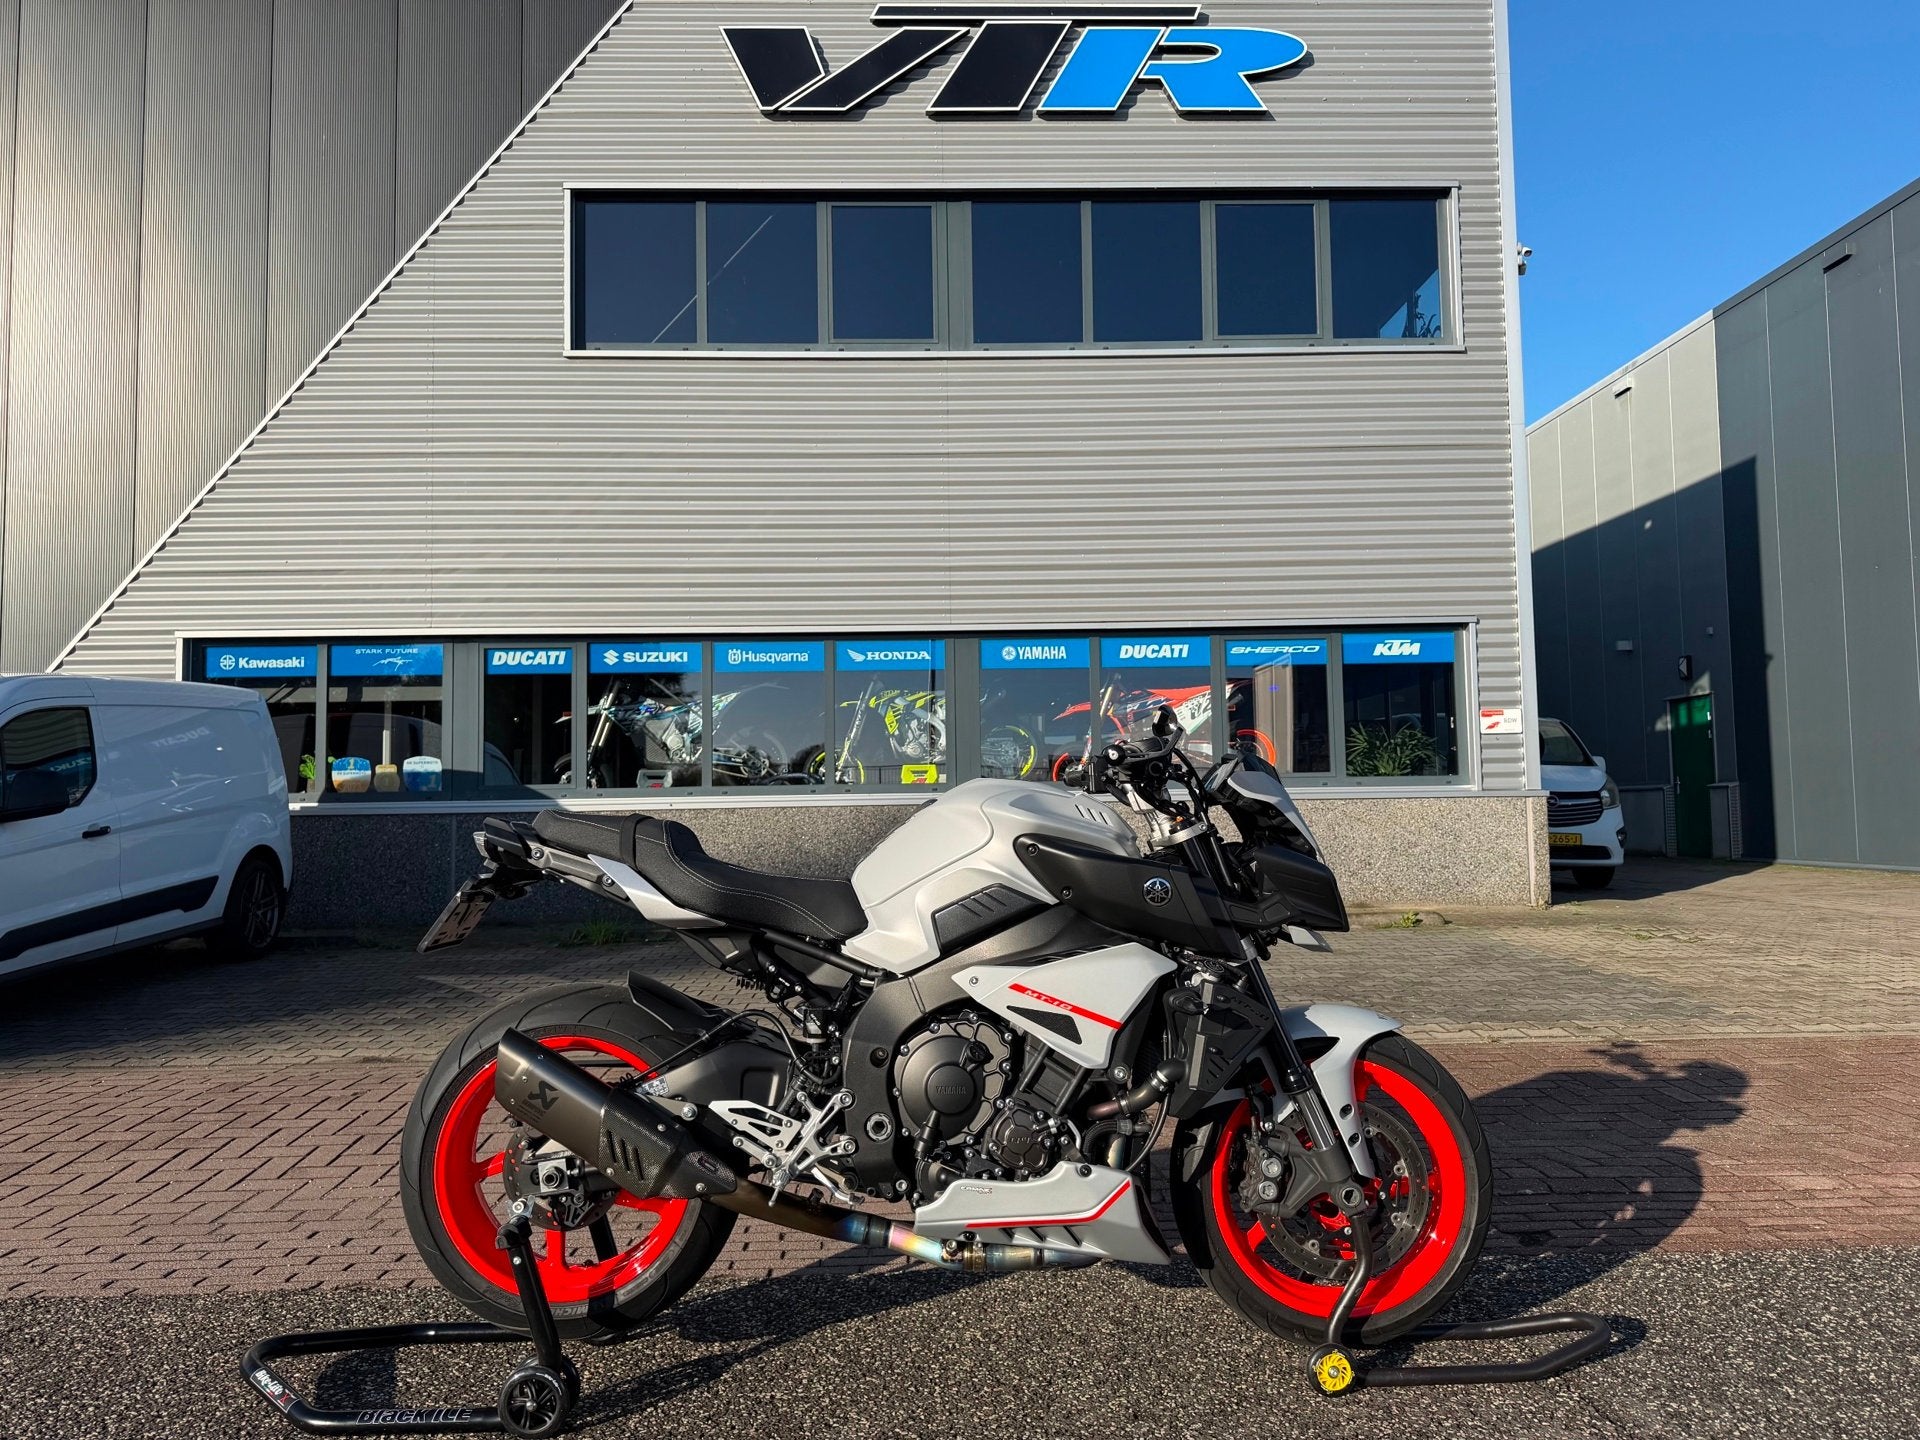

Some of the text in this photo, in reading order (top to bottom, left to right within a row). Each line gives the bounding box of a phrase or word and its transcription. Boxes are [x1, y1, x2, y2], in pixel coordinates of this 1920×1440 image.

[718, 4, 1310, 115] VTR
[1017, 646, 1067, 660] YAMAHA
[1119, 644, 1189, 659] DUCATI
[1230, 645, 1320, 654] SHERCO
[1372, 639, 1421, 656] KTM
[492, 650, 565, 666] DUCATI
[623, 651, 688, 663] SUZUKI
[742, 650, 809, 664] Husqvarna
[866, 650, 931, 661] HONDA
[238, 656, 305, 670] Kawasaki
[1024, 990, 1072, 1010] MT-10
[936, 1085, 967, 1095] YAMAHA
